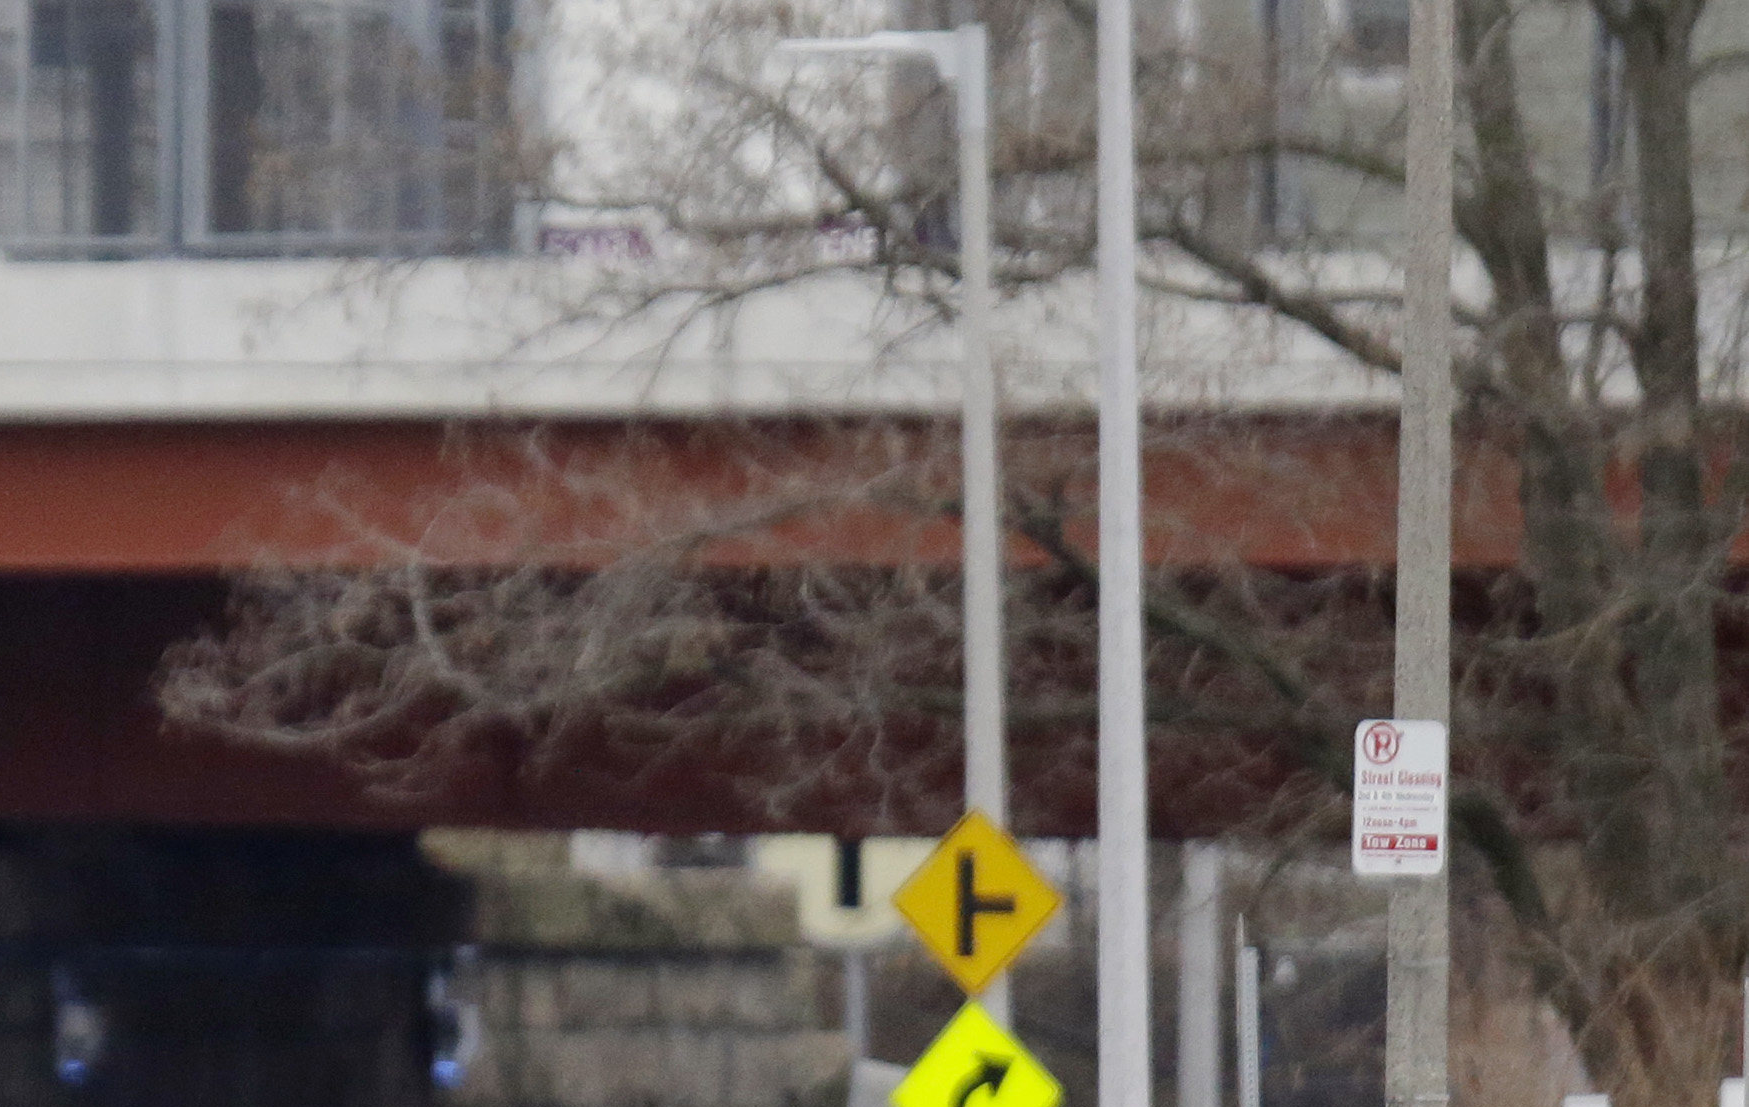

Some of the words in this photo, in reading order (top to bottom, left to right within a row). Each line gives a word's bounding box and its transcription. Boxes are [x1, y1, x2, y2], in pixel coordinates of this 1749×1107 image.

[1361, 771, 1394, 785] Street
[1398, 771, 1442, 787] Cleaning
[1365, 835, 1390, 848] Tow
[1395, 835, 1427, 848] Zone
